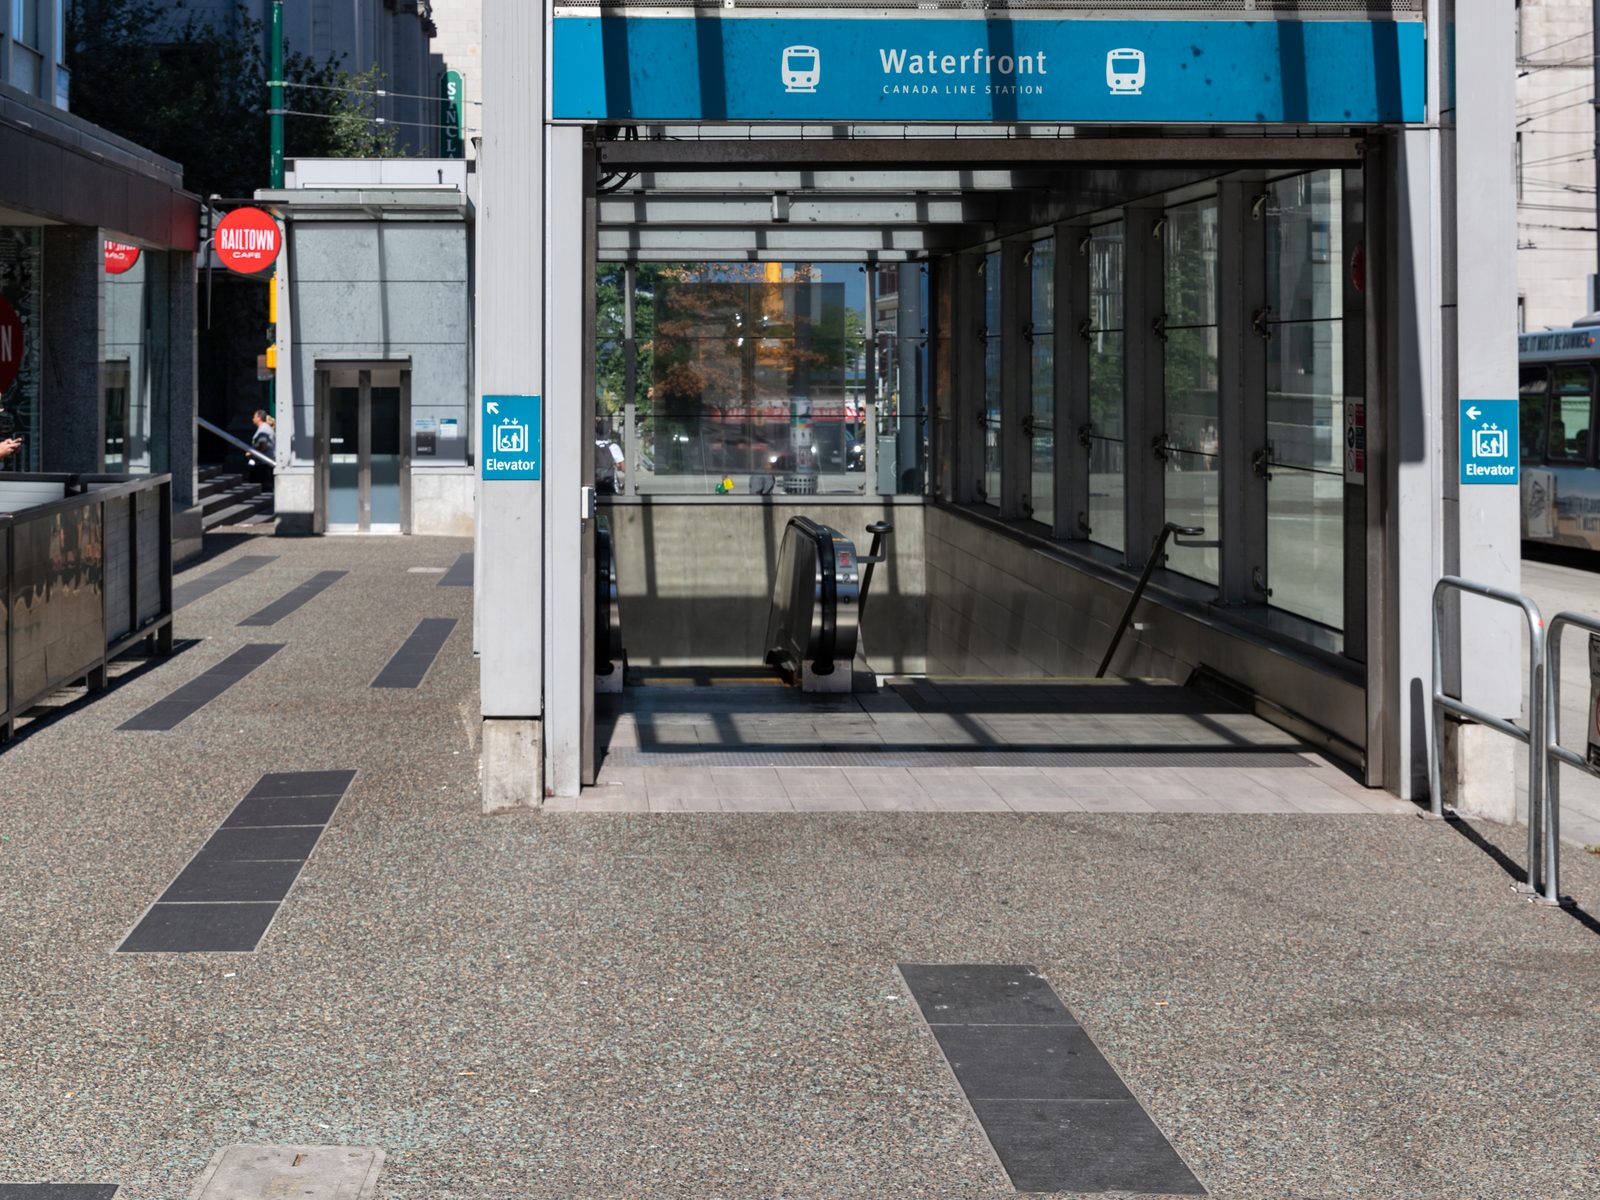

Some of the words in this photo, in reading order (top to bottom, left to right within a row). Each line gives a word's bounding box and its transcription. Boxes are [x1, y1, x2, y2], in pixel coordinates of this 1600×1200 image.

[879, 48, 1047, 75] Waterfront
[883, 85, 938, 95] CANADA
[945, 85, 976, 95] LINE
[985, 85, 1043, 95] STATION
[221, 228, 274, 251] RAILTOWN
[232, 251, 262, 259] CAFE
[486, 458, 535, 471] Elevator
[1466, 463, 1515, 476] Elevator
